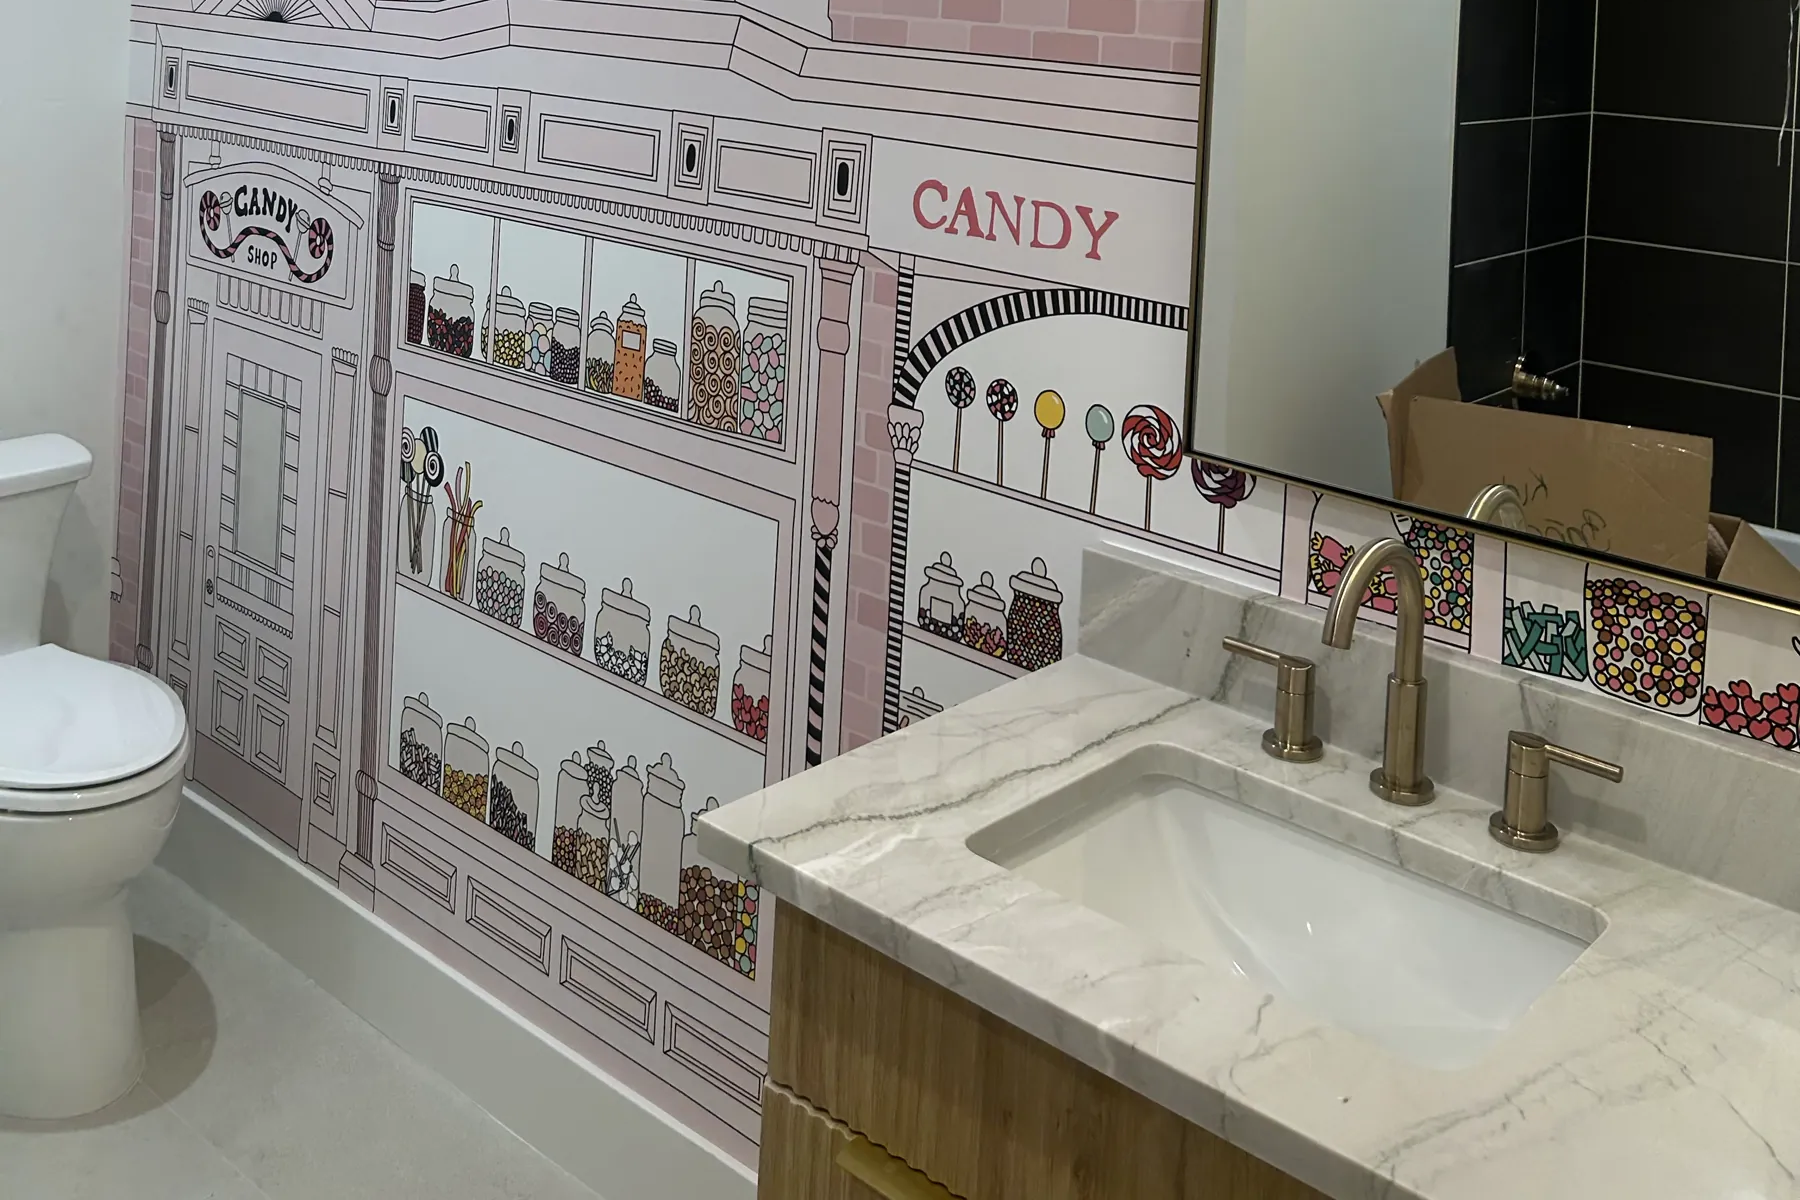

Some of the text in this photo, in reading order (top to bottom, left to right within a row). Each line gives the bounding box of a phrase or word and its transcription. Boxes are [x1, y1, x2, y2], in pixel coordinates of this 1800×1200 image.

[234, 185, 298, 233] CANDY
[913, 179, 1119, 260] CANDY
[247, 245, 278, 270] SHOP
